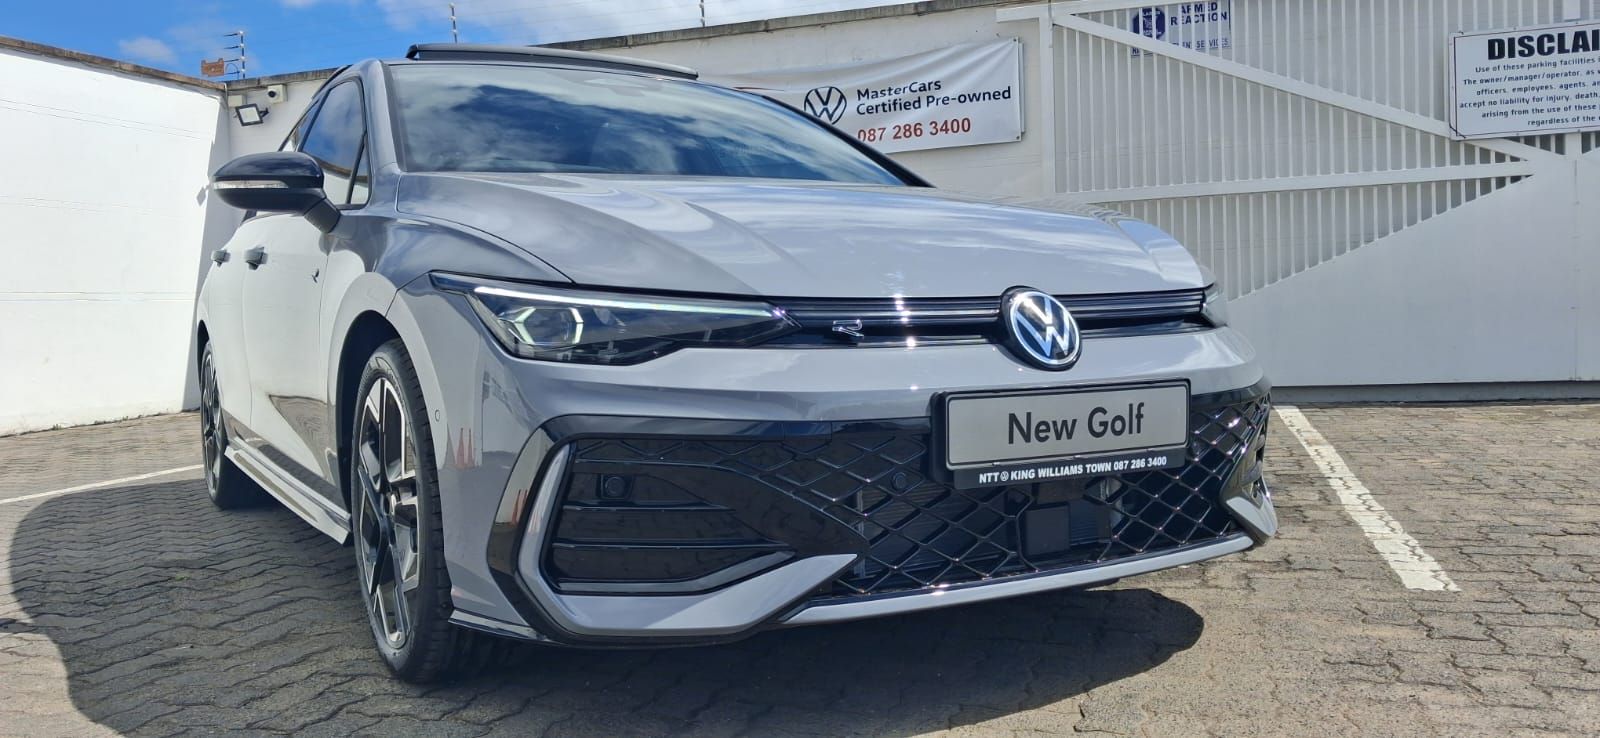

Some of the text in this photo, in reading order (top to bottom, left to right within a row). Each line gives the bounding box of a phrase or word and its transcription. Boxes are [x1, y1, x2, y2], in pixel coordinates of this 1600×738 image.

[1197, 38, 1228, 48] SEVICS
[1488, 29, 1600, 60] DISCLAI
[1528, 61, 1557, 70] parking
[1560, 57, 1595, 66] facilities
[856, 85, 1011, 115] Certified Pre-owned
[857, 80, 942, 101] MasterCars
[1460, 101, 1485, 109] accept
[1500, 97, 1530, 105] liability
[1481, 110, 1509, 118] arising
[1528, 117, 1569, 127] regardless
[858, 117, 971, 142] 087 286 3400
[1008, 402, 1144, 444] New Golf
[979, 471, 1000, 483] NTT
[1010, 468, 1035, 480] KING
[1038, 464, 1083, 477] WILLIAMS
[1085, 462, 1112, 473] TOWN
[1113, 460, 1129, 470] 087
[1130, 458, 1146, 469] 286
[1147, 456, 1167, 467] 3400
